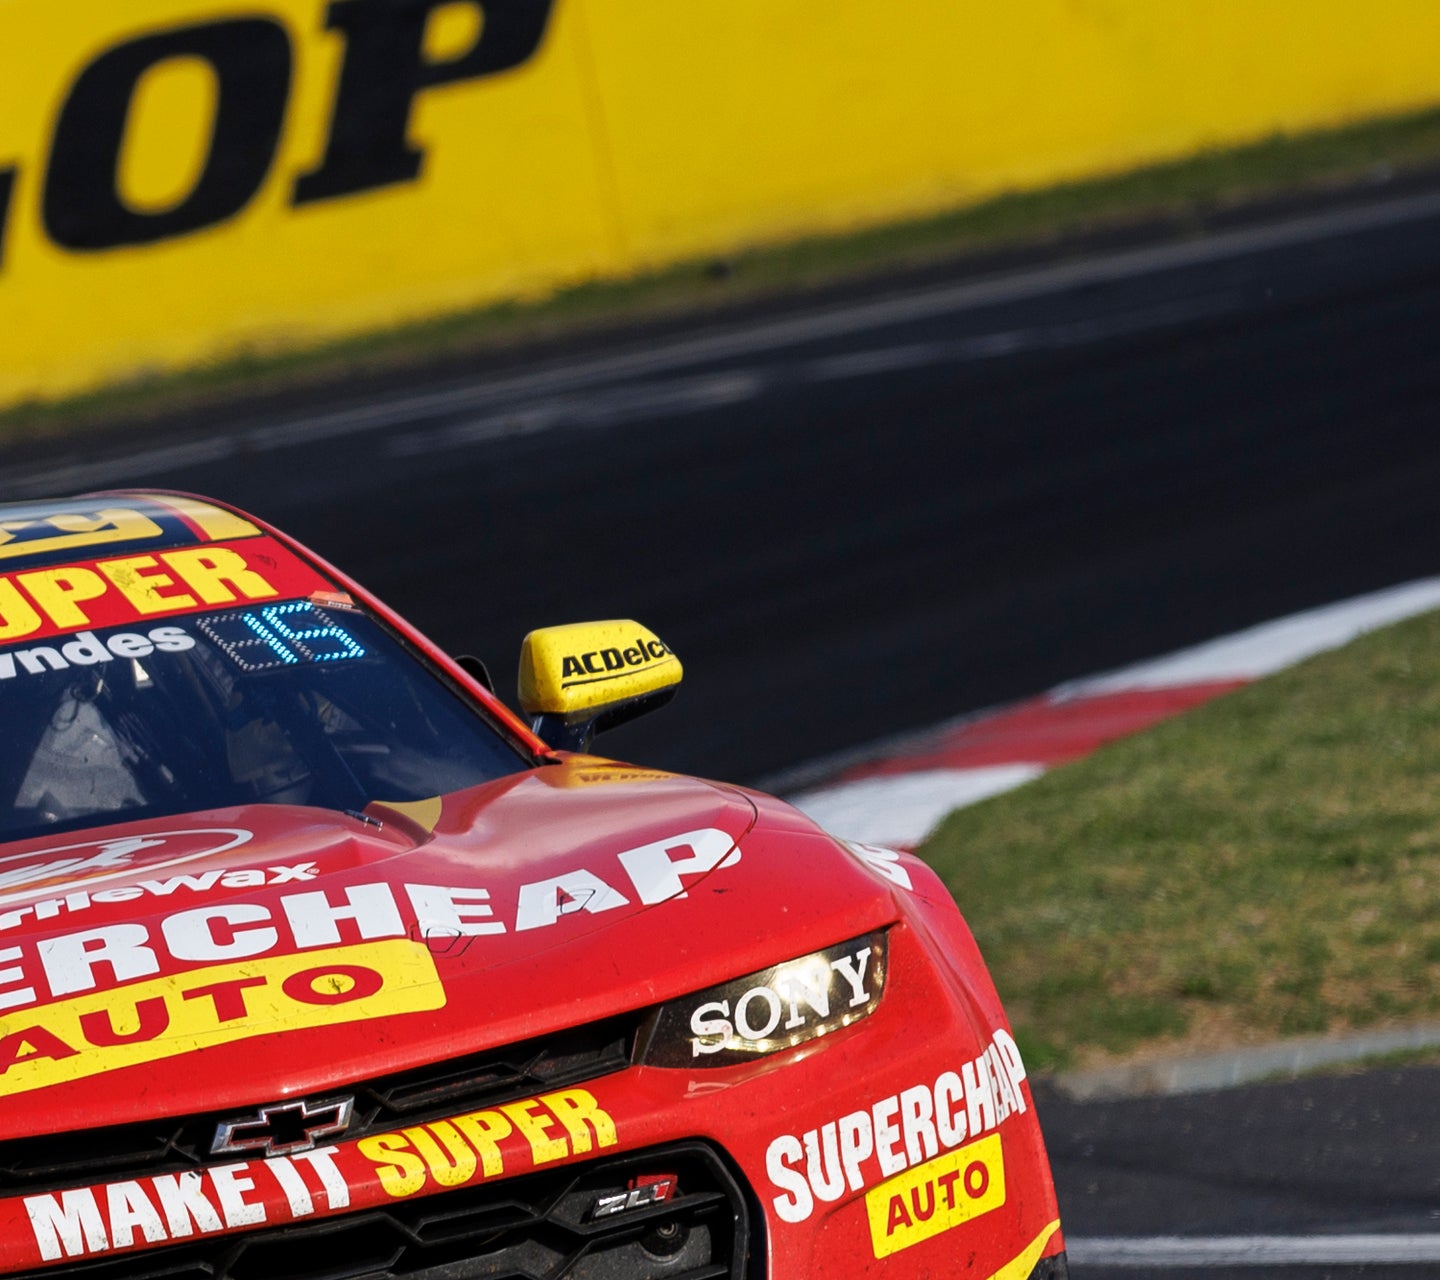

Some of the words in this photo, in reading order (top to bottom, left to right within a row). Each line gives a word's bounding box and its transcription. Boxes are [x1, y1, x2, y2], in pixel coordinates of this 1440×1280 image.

[689, 946, 874, 1059] SONY
[21, 1160, 267, 1262] MAKE
[266, 1144, 353, 1217] IT
[357, 1087, 618, 1199] SUPER
[765, 1026, 1028, 1223] SUPERCHEAP
[594, 1180, 671, 1218] ZL1
[885, 1159, 990, 1237] AUTO
